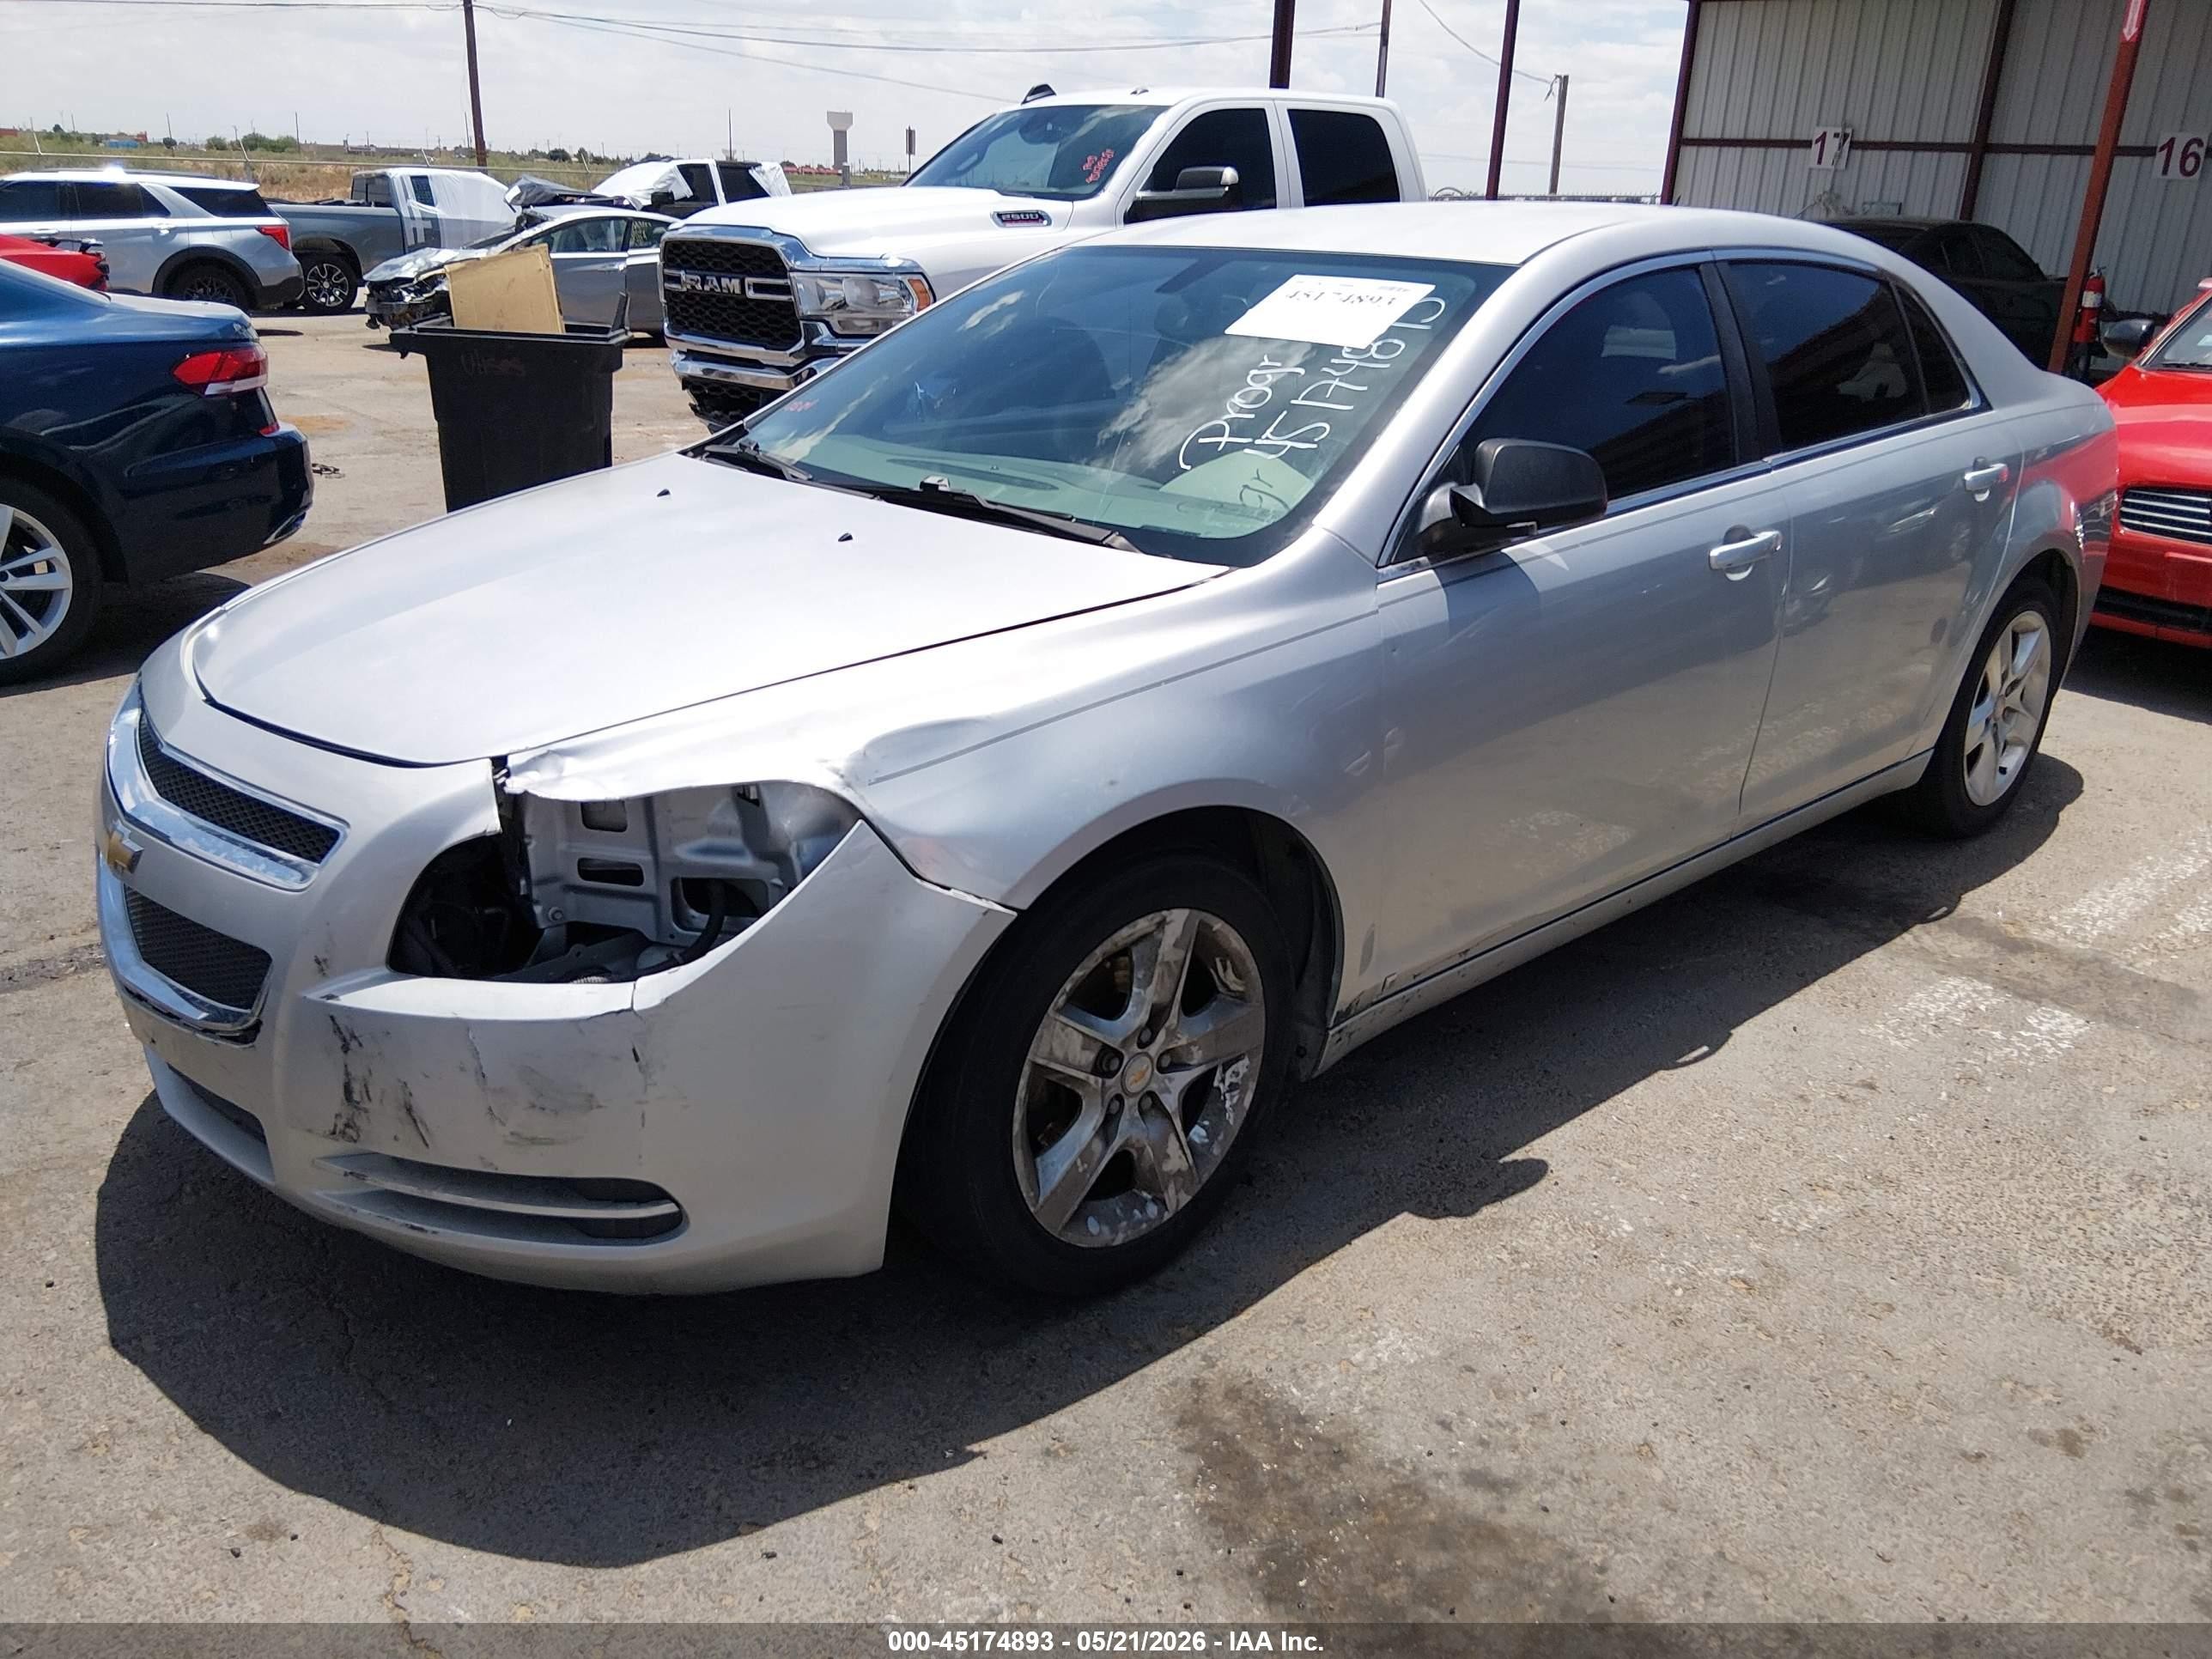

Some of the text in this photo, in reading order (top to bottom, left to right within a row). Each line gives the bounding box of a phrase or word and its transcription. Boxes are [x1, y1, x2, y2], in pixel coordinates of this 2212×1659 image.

[1814, 131, 1850, 167] 17
[2158, 137, 2204, 178] 16
[684, 273, 742, 295] RAM
